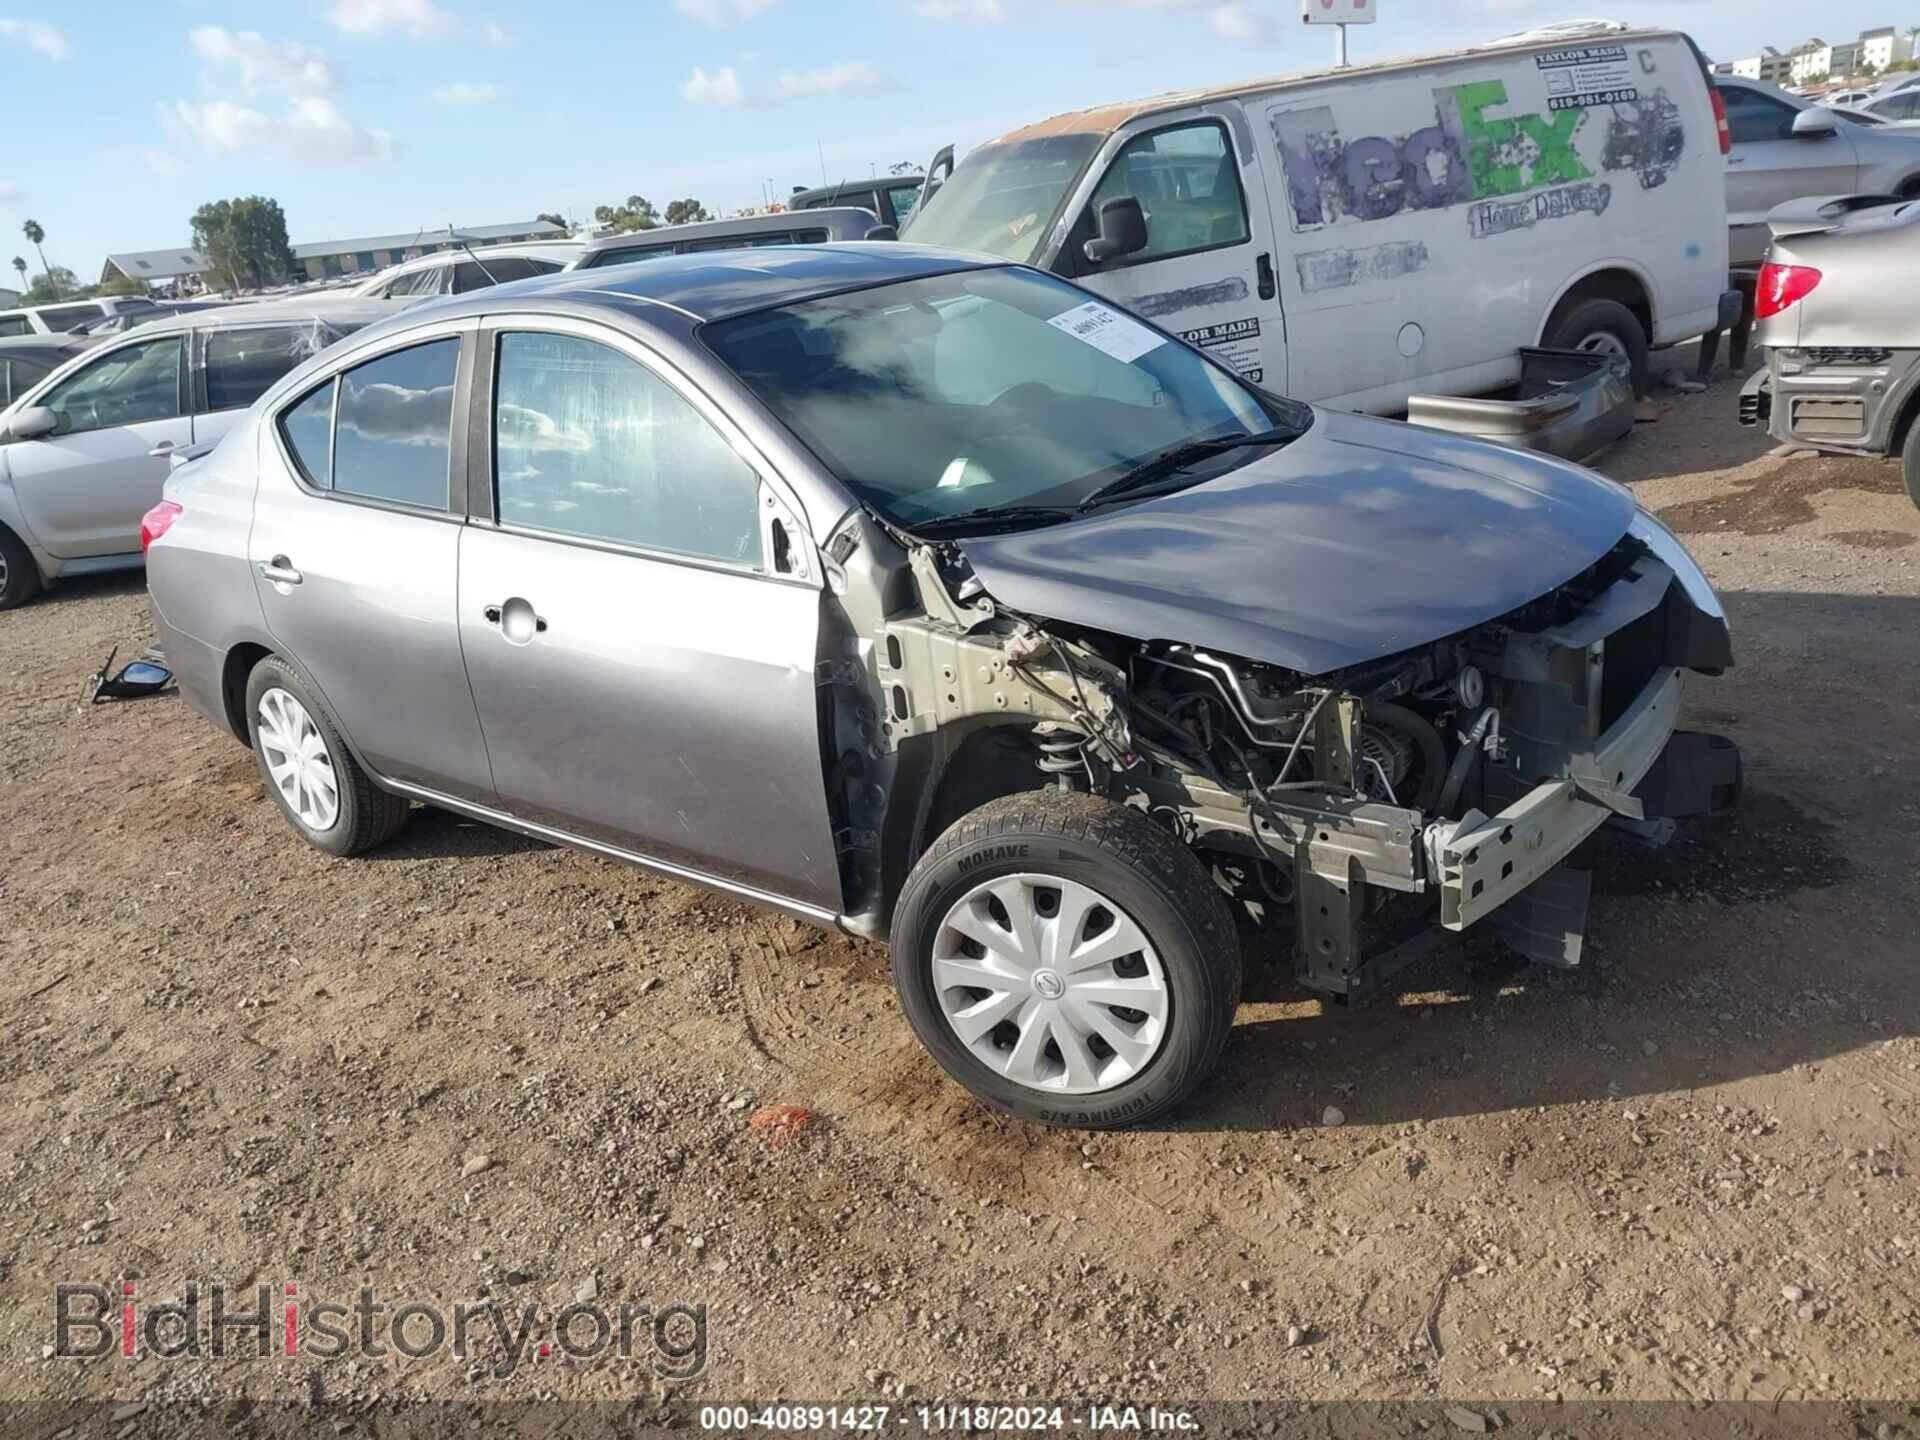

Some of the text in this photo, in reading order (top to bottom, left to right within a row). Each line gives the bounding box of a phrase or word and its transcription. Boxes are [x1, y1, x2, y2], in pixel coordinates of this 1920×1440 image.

[1538, 49, 1587, 62] TAYLOR
[1588, 47, 1626, 58] MADE
[1214, 320, 1258, 336] MADE
[957, 844, 1030, 873] MOHAVE
